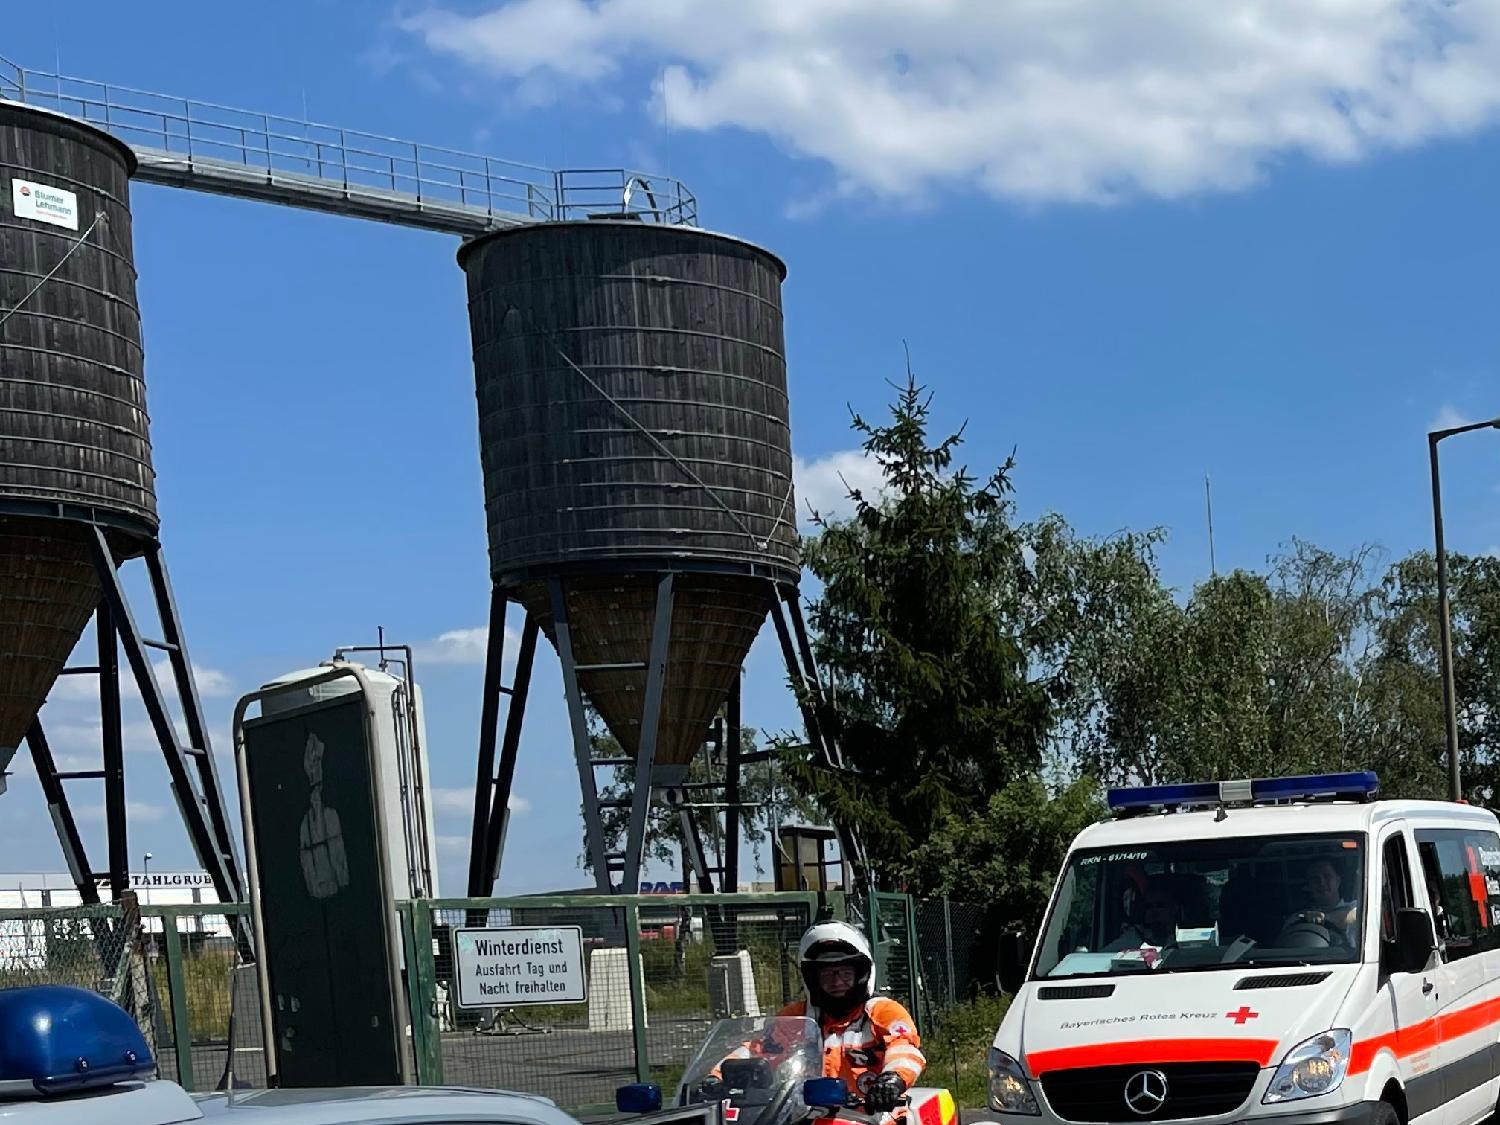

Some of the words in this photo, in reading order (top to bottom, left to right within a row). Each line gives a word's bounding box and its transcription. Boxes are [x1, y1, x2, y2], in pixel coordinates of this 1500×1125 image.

[129, 875, 212, 886] TAHLGRUB
[474, 938, 564, 956] Winterdienst
[475, 962, 522, 977] Ausfahrt
[525, 961, 544, 977] Tag
[549, 960, 568, 973] und
[479, 981, 510, 996] Nacht
[515, 980, 566, 994] freihalten
[1060, 1015, 1136, 1029] Bayerisches
[1140, 1012, 1177, 1021] Rotes
[1179, 1011, 1218, 1019] Kreuz
